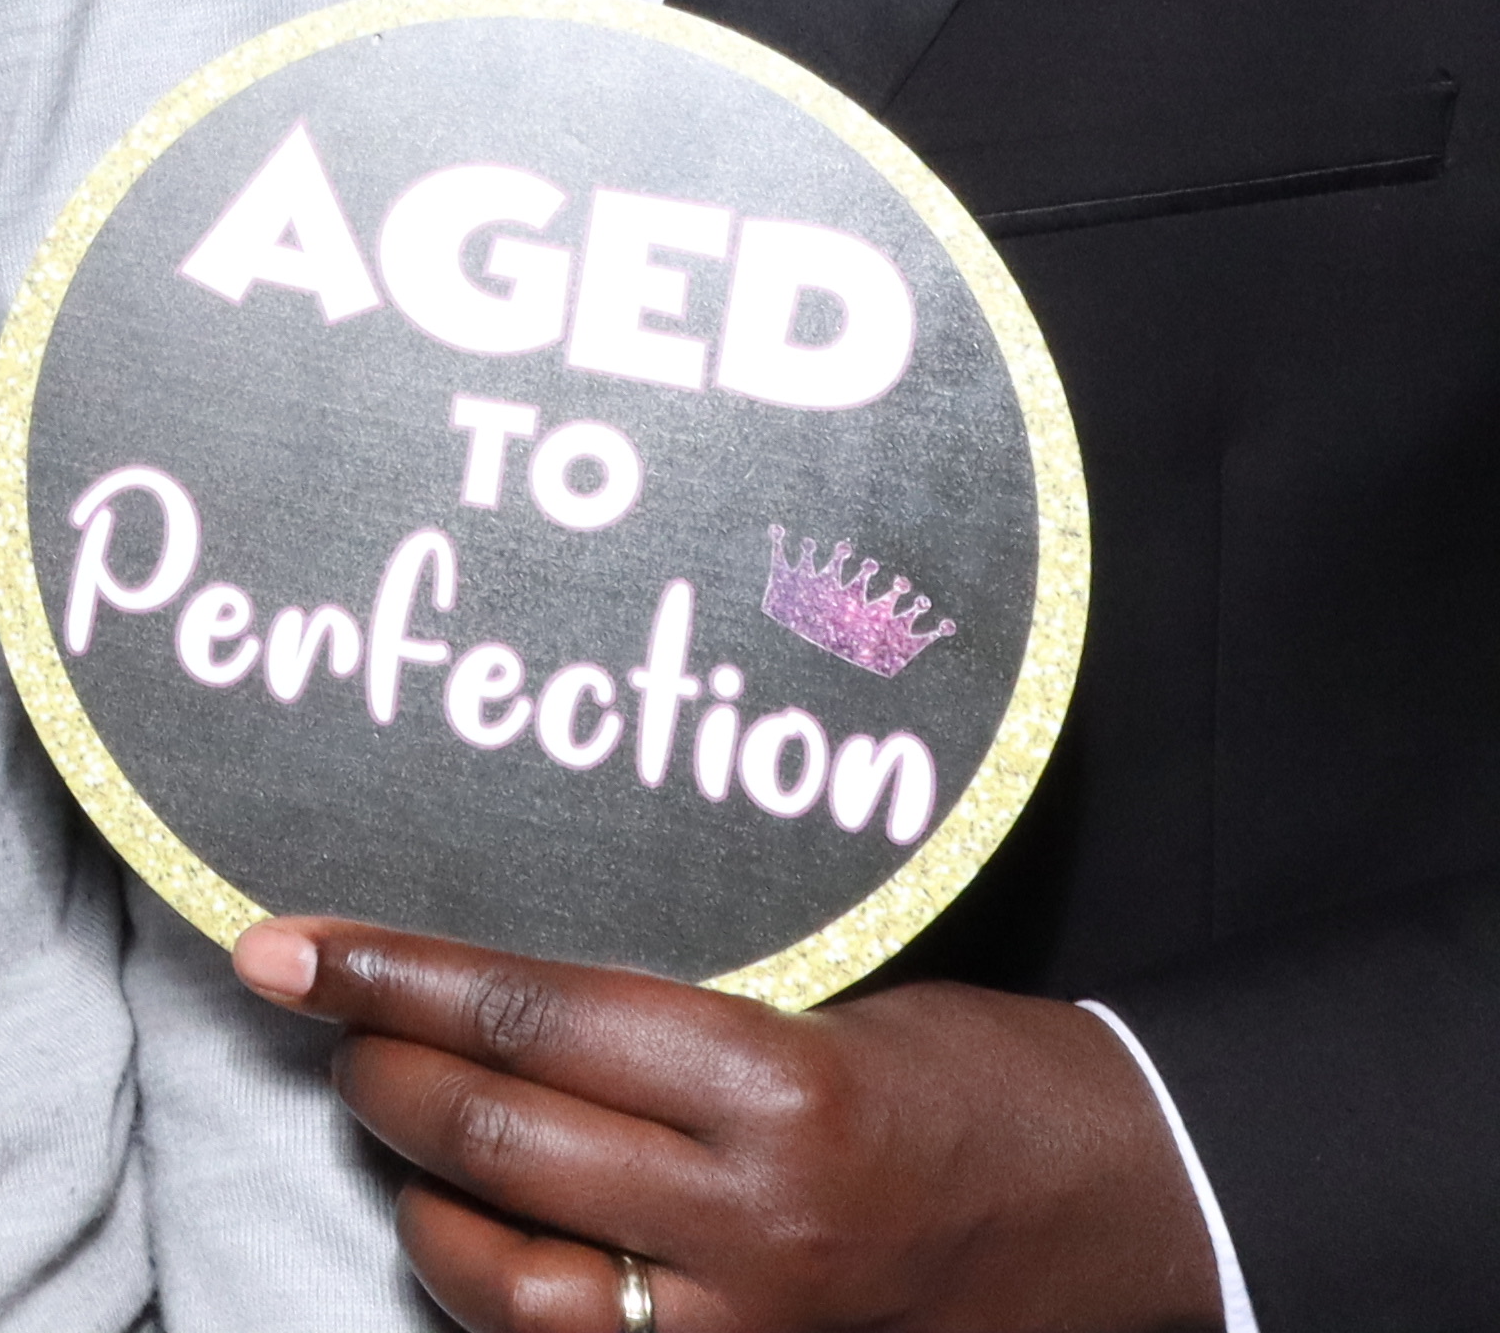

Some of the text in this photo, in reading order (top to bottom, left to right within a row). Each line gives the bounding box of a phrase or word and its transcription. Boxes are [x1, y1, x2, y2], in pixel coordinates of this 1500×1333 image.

[179, 119, 916, 410] AGED
[451, 395, 642, 530] TO
[67, 465, 936, 845] Perfection
